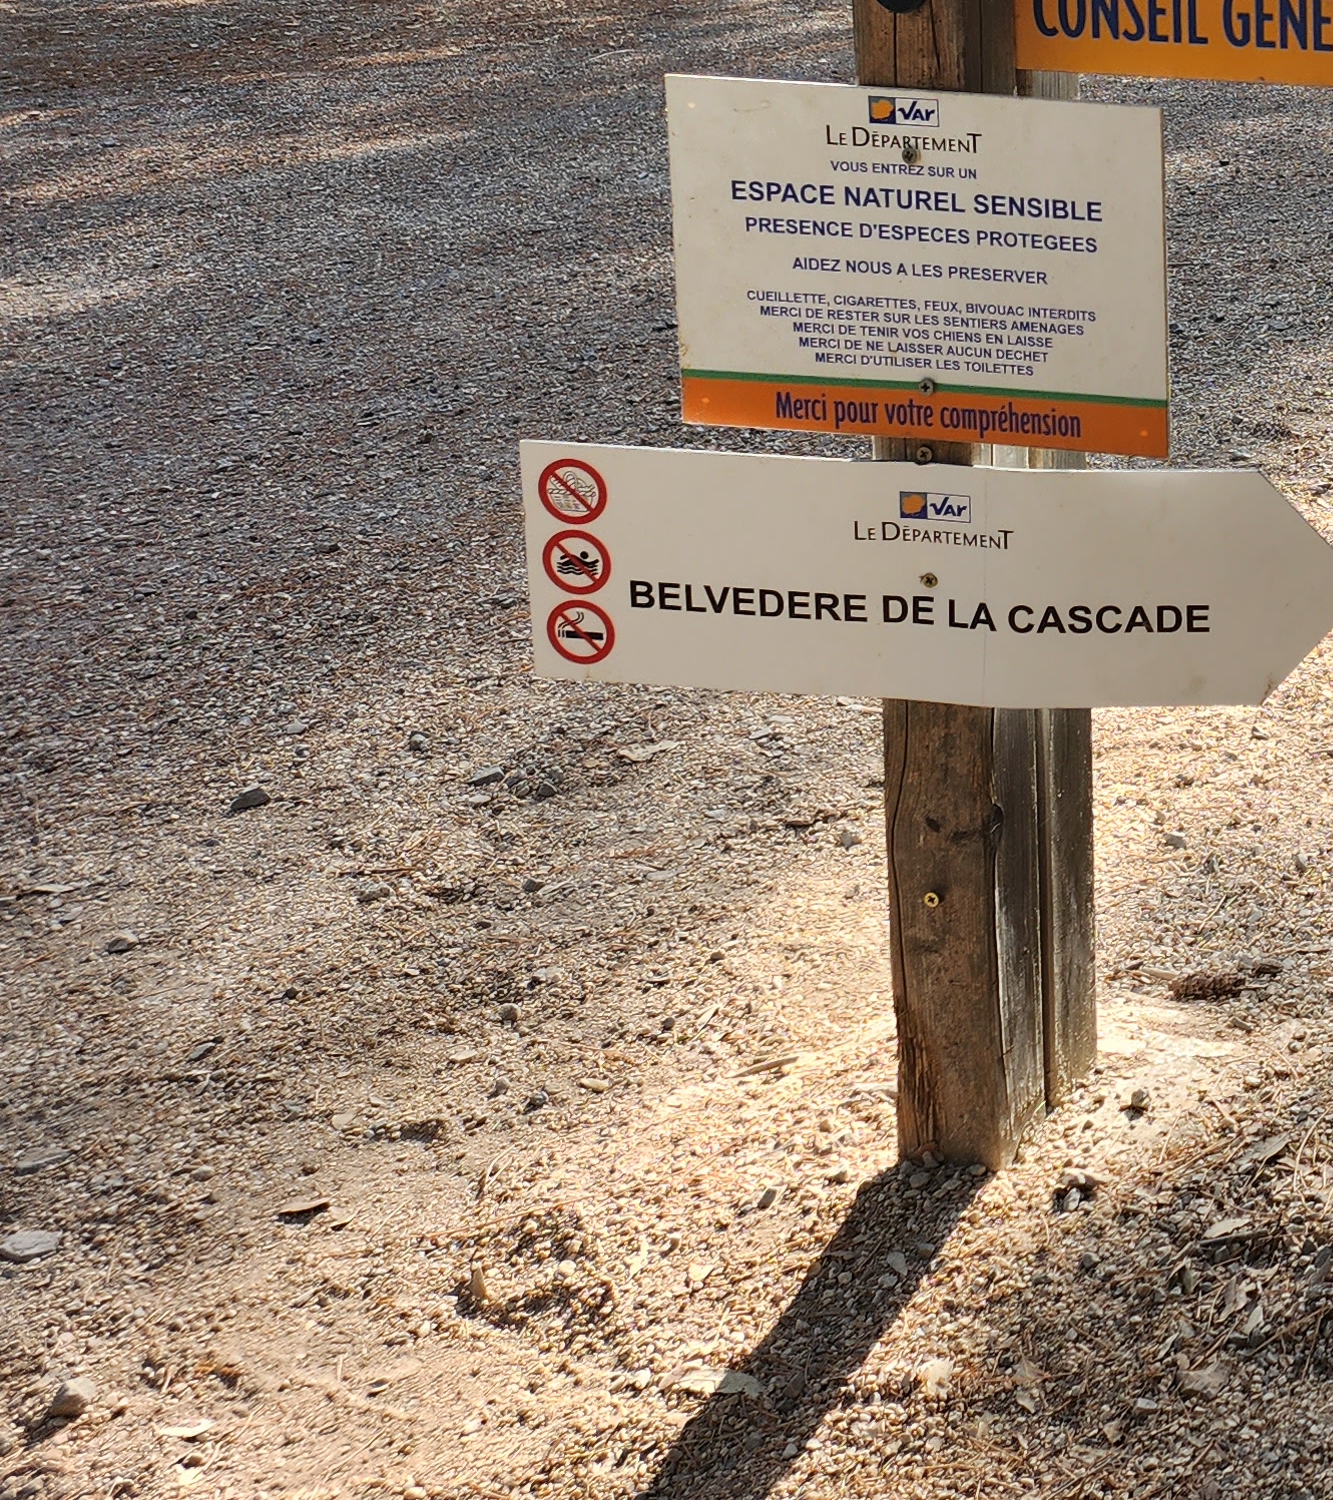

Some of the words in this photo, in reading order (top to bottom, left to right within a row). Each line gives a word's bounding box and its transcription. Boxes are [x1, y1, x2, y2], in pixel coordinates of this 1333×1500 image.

[826, 124, 847, 146] LE
[830, 160, 868, 172] VOUS
[872, 163, 925, 175] ENTREZ
[928, 167, 955, 178] SUR
[958, 169, 977, 179] UN
[731, 180, 836, 205] ESPACE
[844, 186, 966, 213] NATUREL
[973, 194, 1103, 222] SENSIBLE
[745, 216, 853, 238] PRESENCE
[859, 223, 970, 244] D'ESPECES
[976, 230, 1098, 253] PROTEGEES
[792, 257, 841, 272] AIDEZ
[846, 260, 892, 275] NOUS
[896, 263, 908, 276] A
[912, 264, 943, 278] LES
[949, 266, 1048, 285] PRESERVER
[747, 290, 830, 306] CUEILLETTE,
[833, 294, 920, 311] CIGARETTES,
[924, 300, 962, 314] FEUX,
[966, 303, 1023, 317] BIVOUAC
[1028, 306, 1096, 322] INTERDITS
[760, 305, 802, 318] MERCI
[805, 307, 824, 319] DE
[827, 309, 880, 322] RESTER
[883, 311, 911, 324] SUR
[915, 313, 940, 326] LES
[943, 314, 1008, 330] SENTIERS
[1010, 320, 1085, 336] AMENAGES
[792, 322, 835, 334] MERCI
[838, 323, 858, 335] DE
[861, 325, 900, 338] TENIR
[902, 328, 930, 340] VOS
[934, 329, 982, 344] CHIENS
[986, 332, 1004, 345] EN
[1007, 334, 1053, 348] LAISSE
[798, 336, 841, 349] MERCI
[844, 338, 864, 351] DE
[867, 339, 884, 352] NE
[888, 341, 944, 355] LAISSER
[946, 345, 992, 358] AUCUN
[995, 348, 1048, 363] DECHET
[815, 352, 857, 366] MERCI
[860, 355, 933, 369] D'UTILISER
[935, 359, 961, 371] LES
[964, 361, 1034, 376] TOILETTES
[776, 391, 827, 421] Merci
[834, 399, 878, 429] pour
[884, 399, 934, 427] votre
[940, 402, 1081, 438] compréhension
[629, 579, 868, 624] BELVEDERE
[882, 594, 935, 626] DE
[947, 599, 998, 632] LA
[1008, 604, 1212, 634] CASCADE
